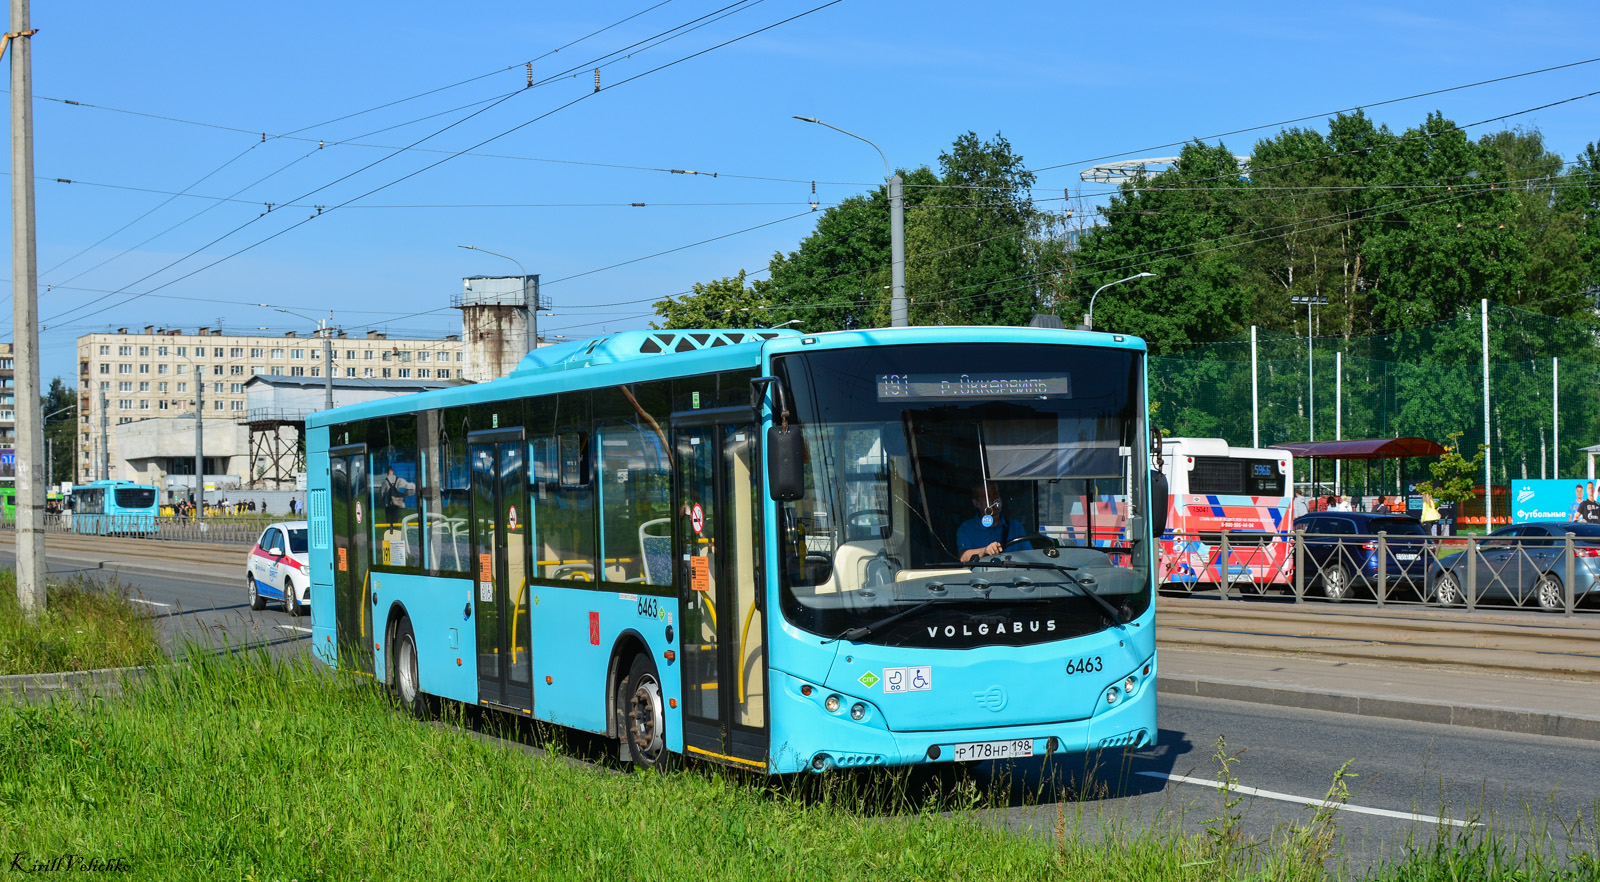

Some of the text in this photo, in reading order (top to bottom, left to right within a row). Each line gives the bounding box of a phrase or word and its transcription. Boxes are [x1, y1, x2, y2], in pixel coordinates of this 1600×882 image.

[882, 374, 908, 395] 191
[1517, 509, 1566, 520] Футбольные
[637, 596, 658, 618] 6463
[927, 619, 1056, 638] VOLGABUS
[1065, 656, 1103, 675] 6463
[1011, 740, 1031, 752] 198
